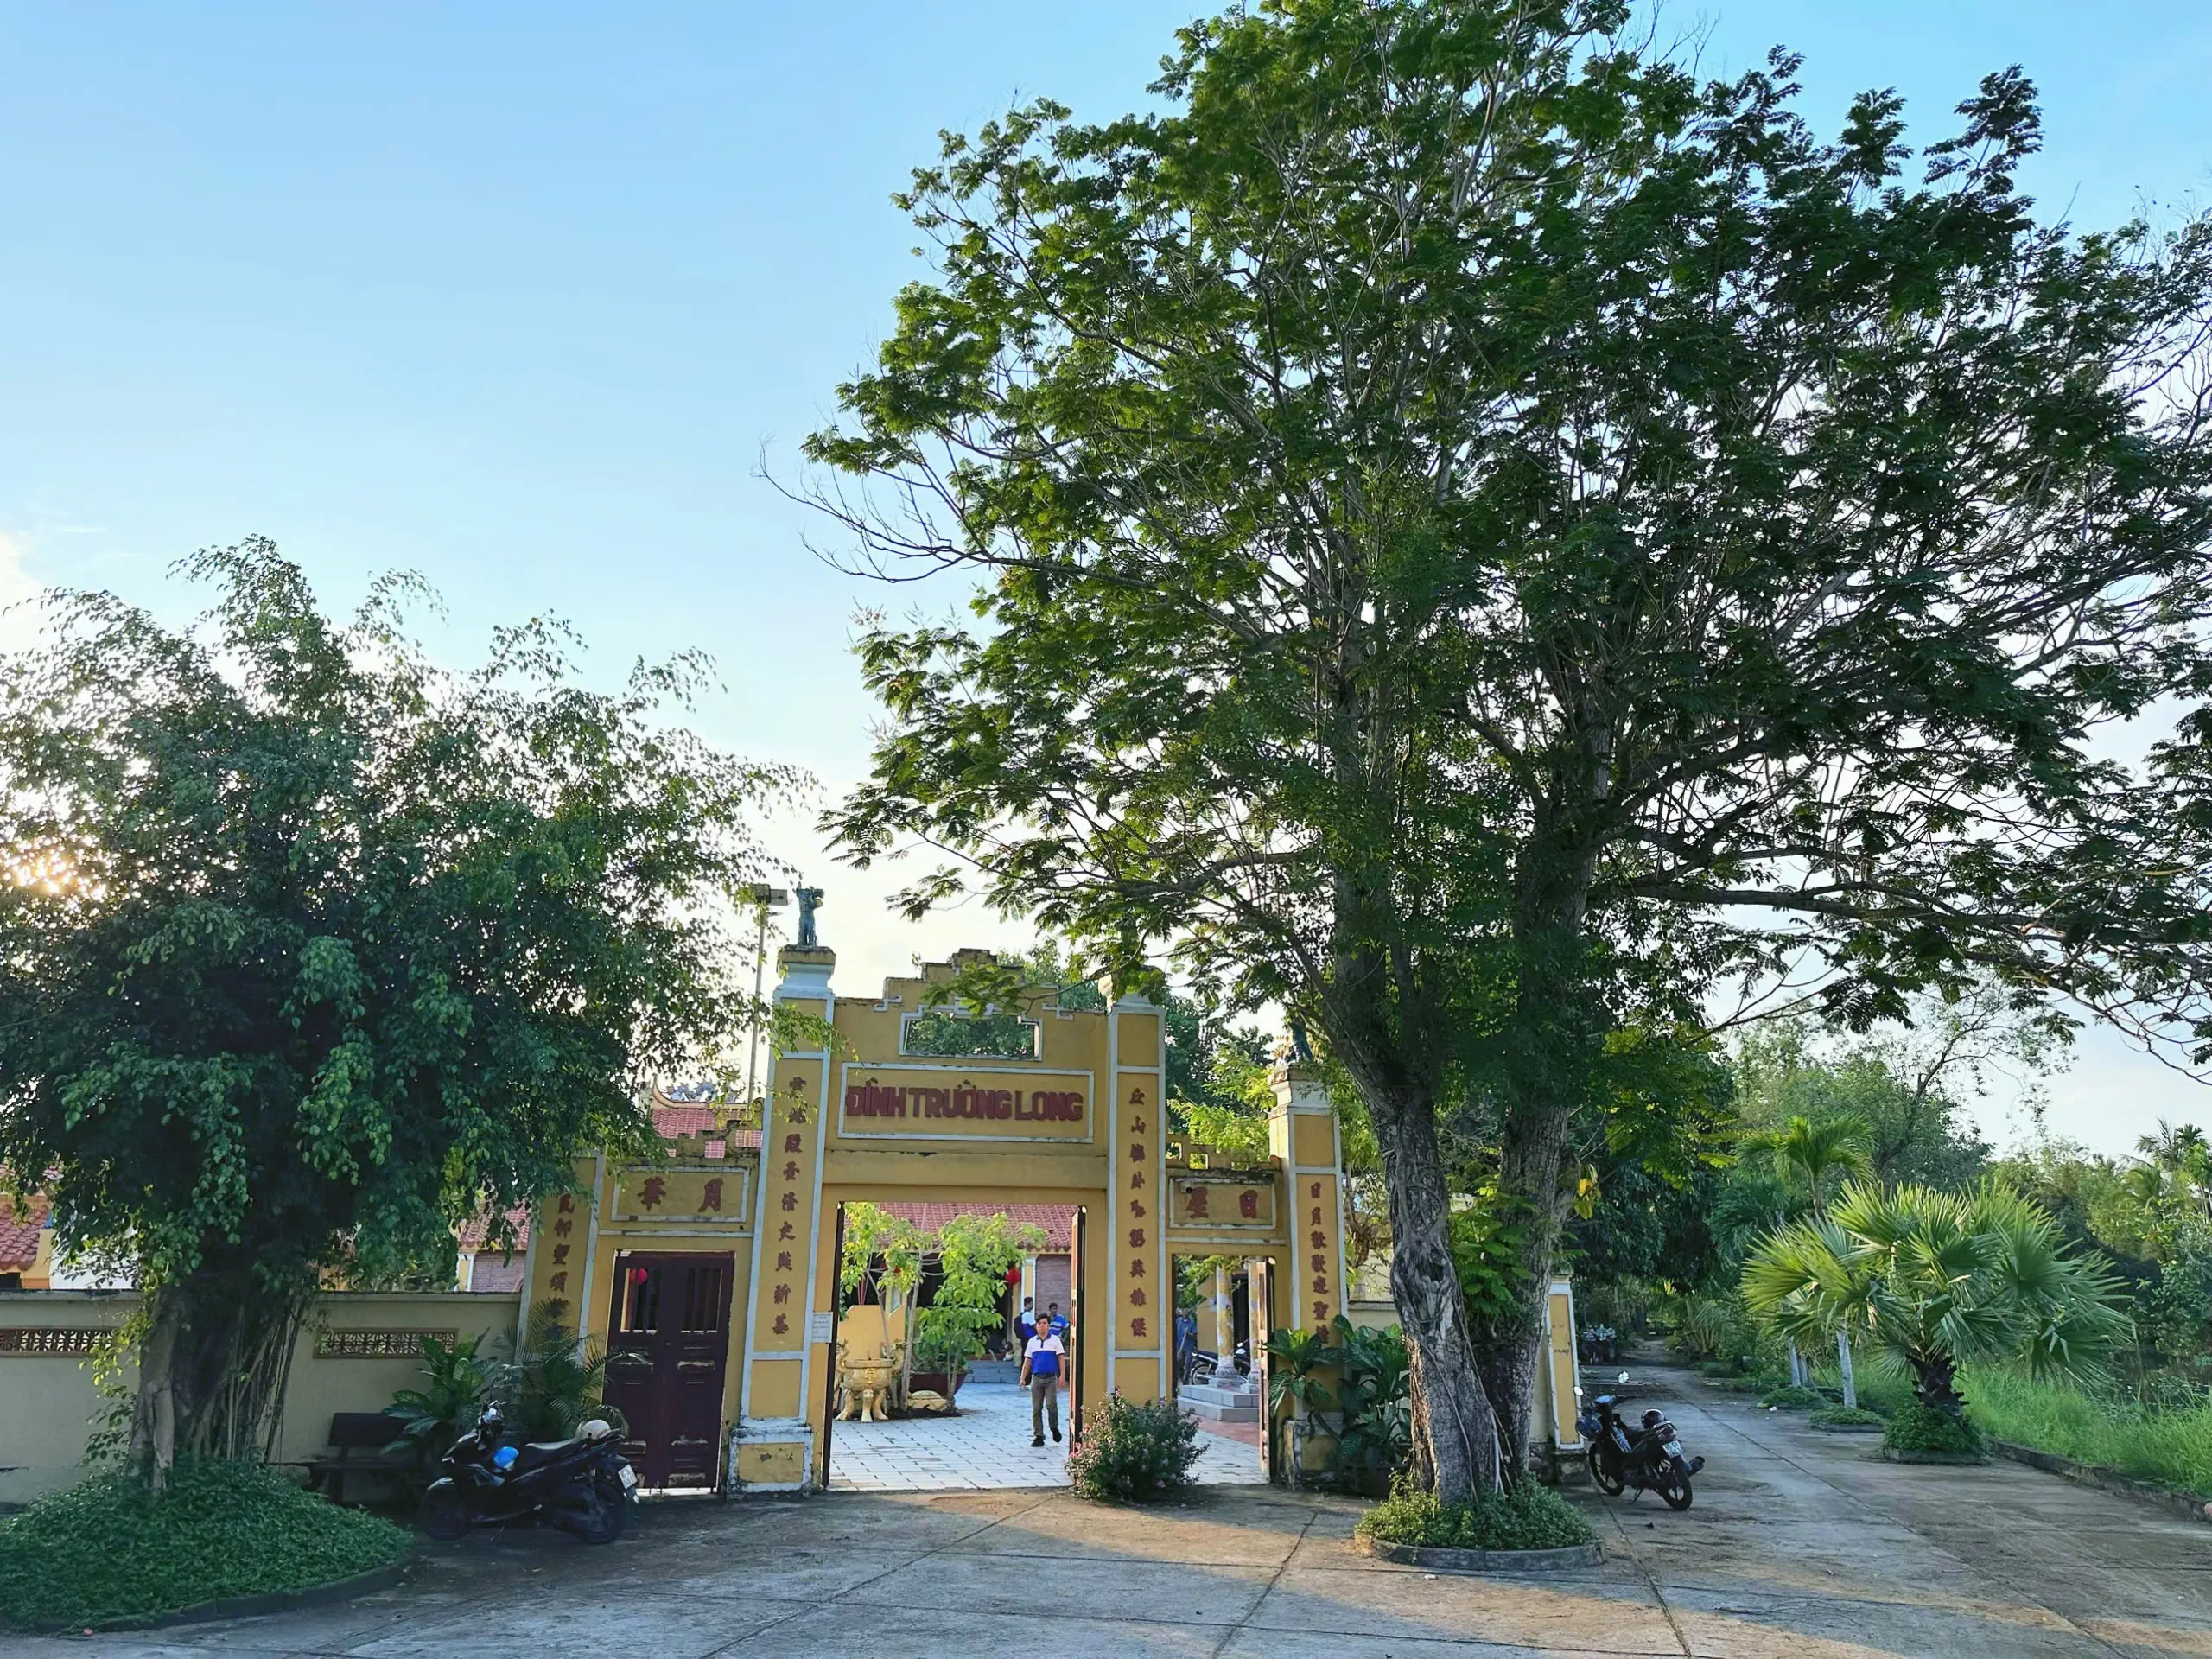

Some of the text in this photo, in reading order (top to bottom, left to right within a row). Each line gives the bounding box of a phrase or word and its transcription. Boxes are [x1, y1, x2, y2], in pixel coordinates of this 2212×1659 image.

[845, 1077, 1084, 1122] ĐÌNH TRƯỜNG LONG
